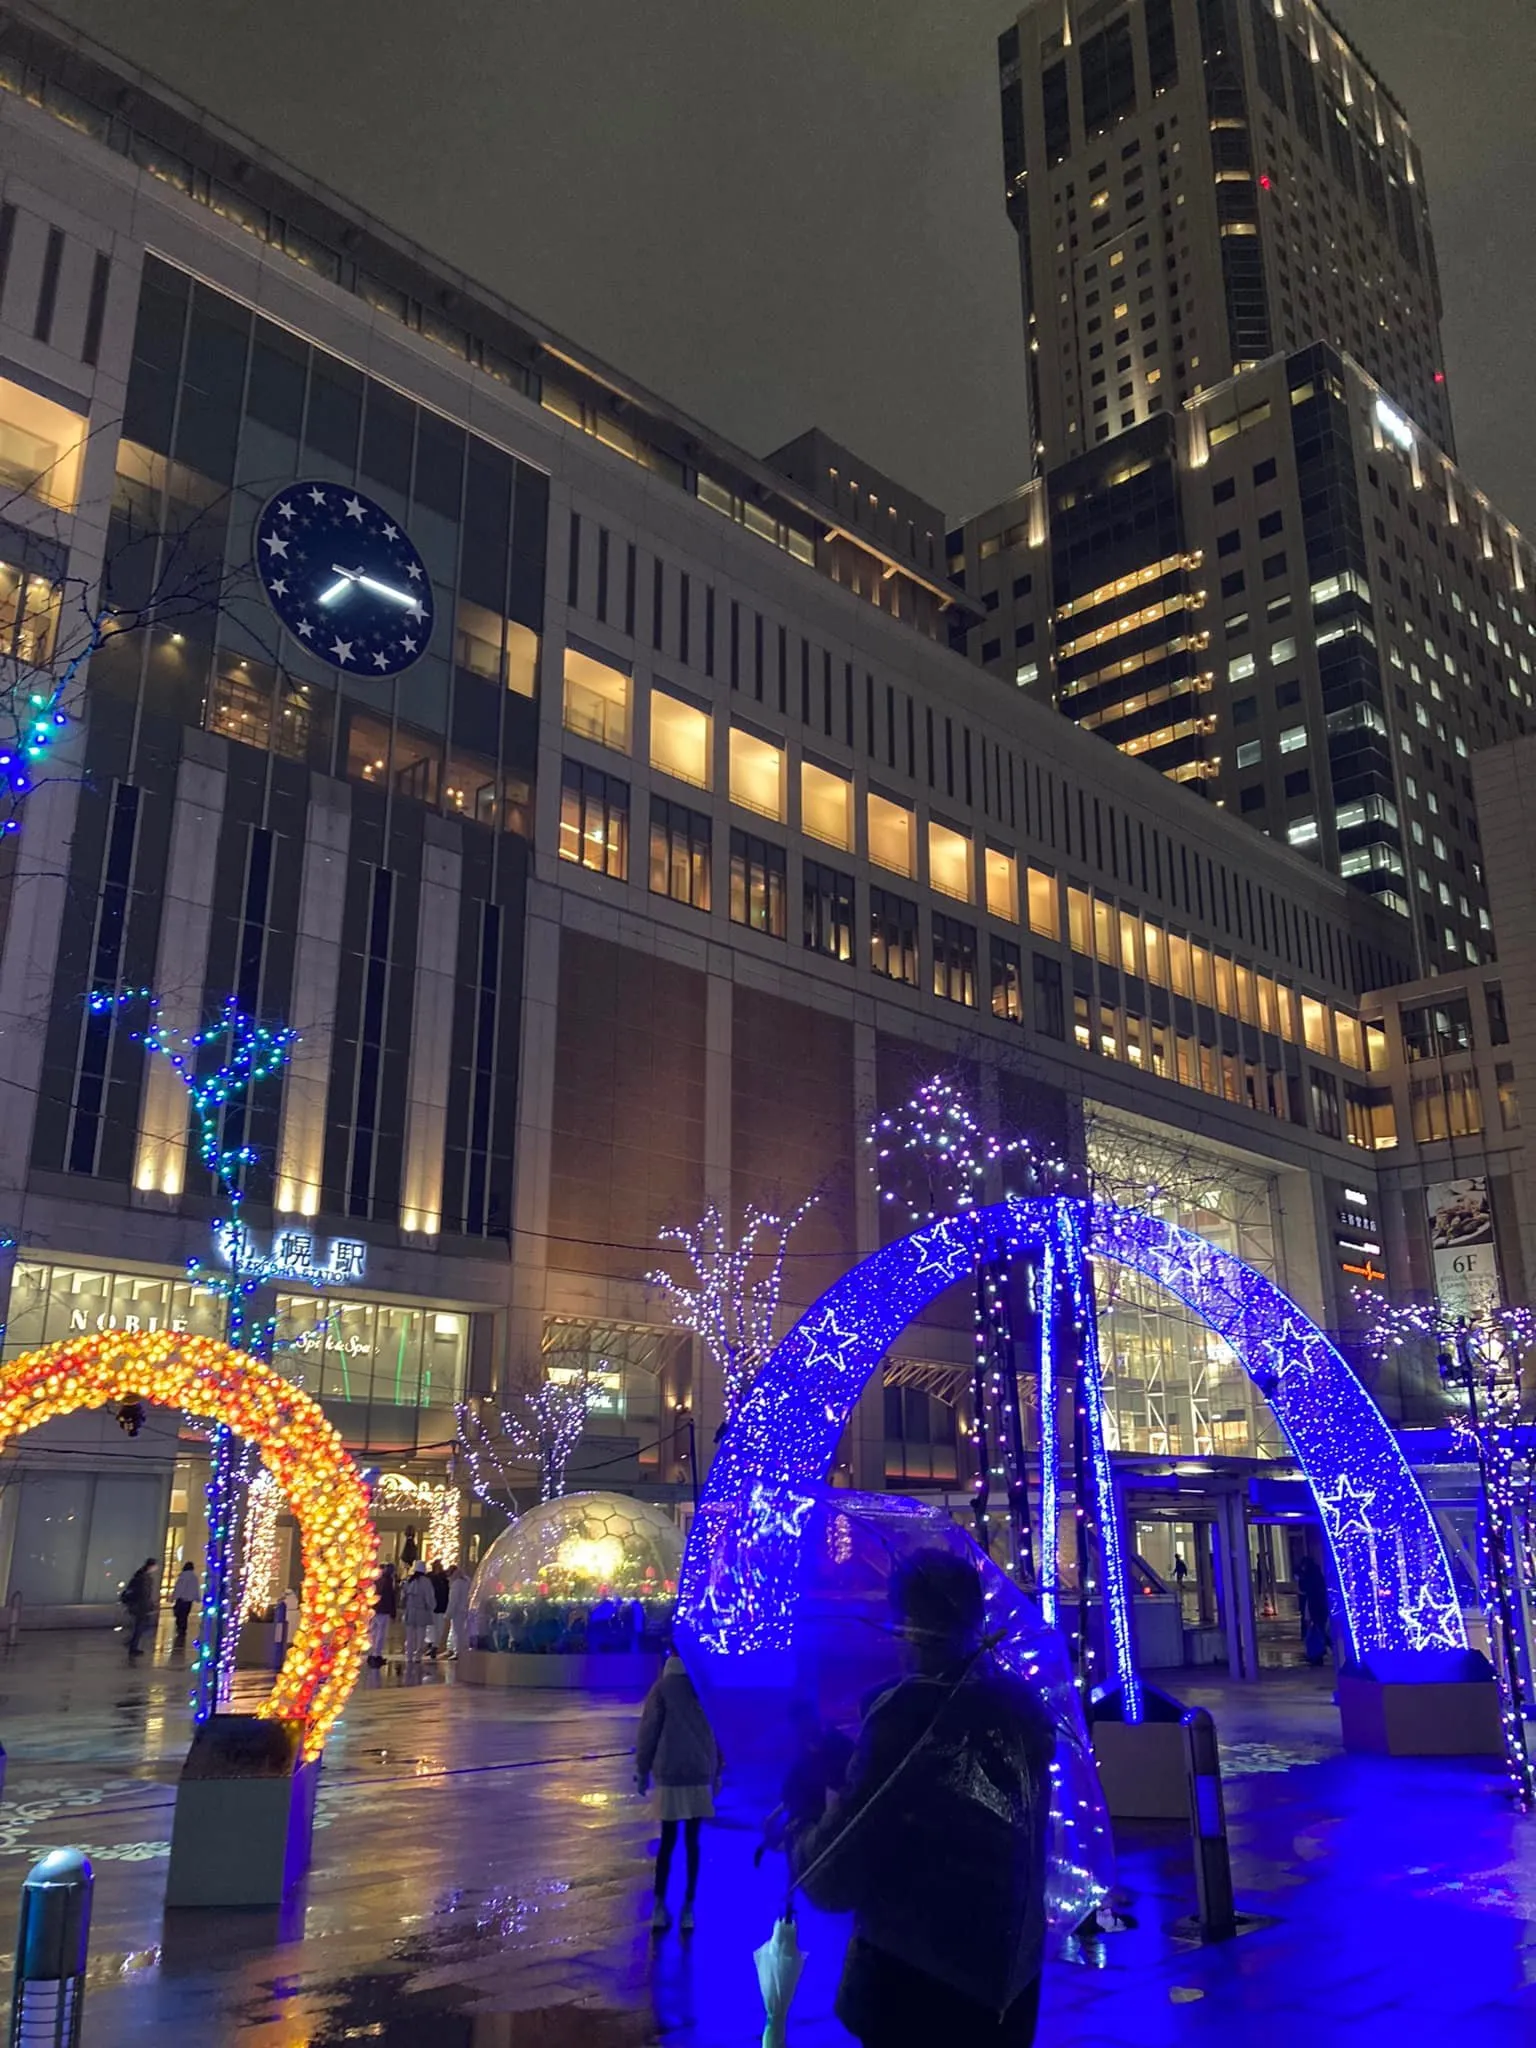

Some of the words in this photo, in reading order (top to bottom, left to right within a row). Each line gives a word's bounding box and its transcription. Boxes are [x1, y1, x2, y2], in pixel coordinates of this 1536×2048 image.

[224, 1227, 364, 1274] 札幌駅
[1453, 1254, 1477, 1273] 6F
